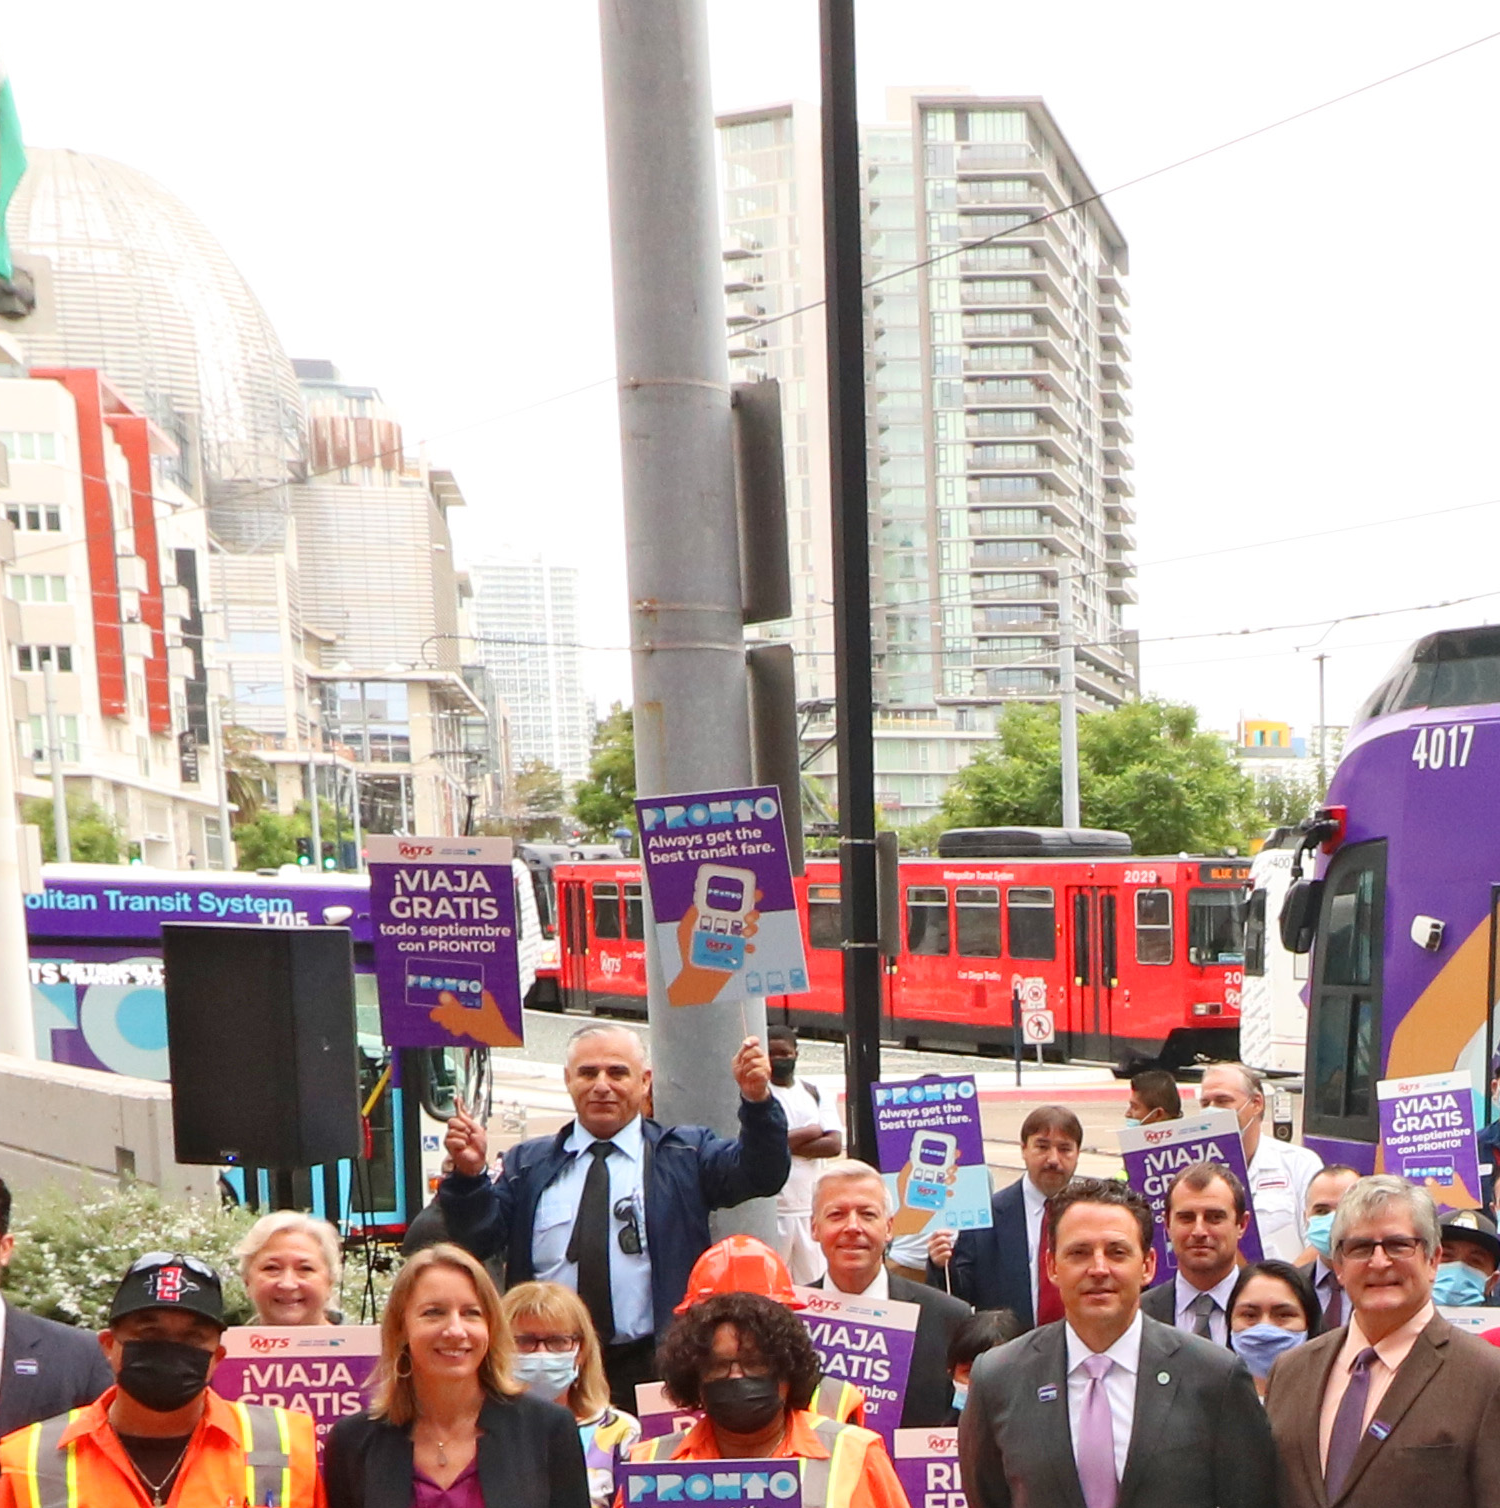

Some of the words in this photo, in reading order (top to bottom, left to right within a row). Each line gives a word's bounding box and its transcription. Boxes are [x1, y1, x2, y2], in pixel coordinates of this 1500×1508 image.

[1412, 725, 1475, 770] 4017
[642, 797, 778, 831] PRONTO
[648, 834, 703, 849] Always
[706, 829, 732, 846] get
[735, 827, 762, 841] the
[650, 851, 685, 864] best
[688, 844, 739, 861] transit
[741, 842, 775, 857] fare.
[394, 869, 491, 897] ¡VIAJA
[1124, 870, 1157, 883] 2029
[1211, 868, 1233, 880] BLUE
[103, 889, 192, 912] Transit
[198, 891, 293, 917] System
[390, 896, 499, 921] GRATIS
[379, 922, 417, 936] todo
[420, 923, 511, 939] septiembre
[397, 941, 425, 953] con
[427, 939, 496, 954] PRONTO!
[1224, 972, 1241, 984] 20
[875, 1081, 975, 1106] PRONTO
[879, 1107, 921, 1121] Always
[1395, 1094, 1458, 1118] ¡VIAJA
[907, 1115, 944, 1129] transit
[1392, 1110, 1463, 1133] GRATIS
[1412, 1128, 1471, 1143] septiembre
[243, 1363, 354, 1392] ¡VIAJA
[628, 1471, 798, 1502] PRONTO
